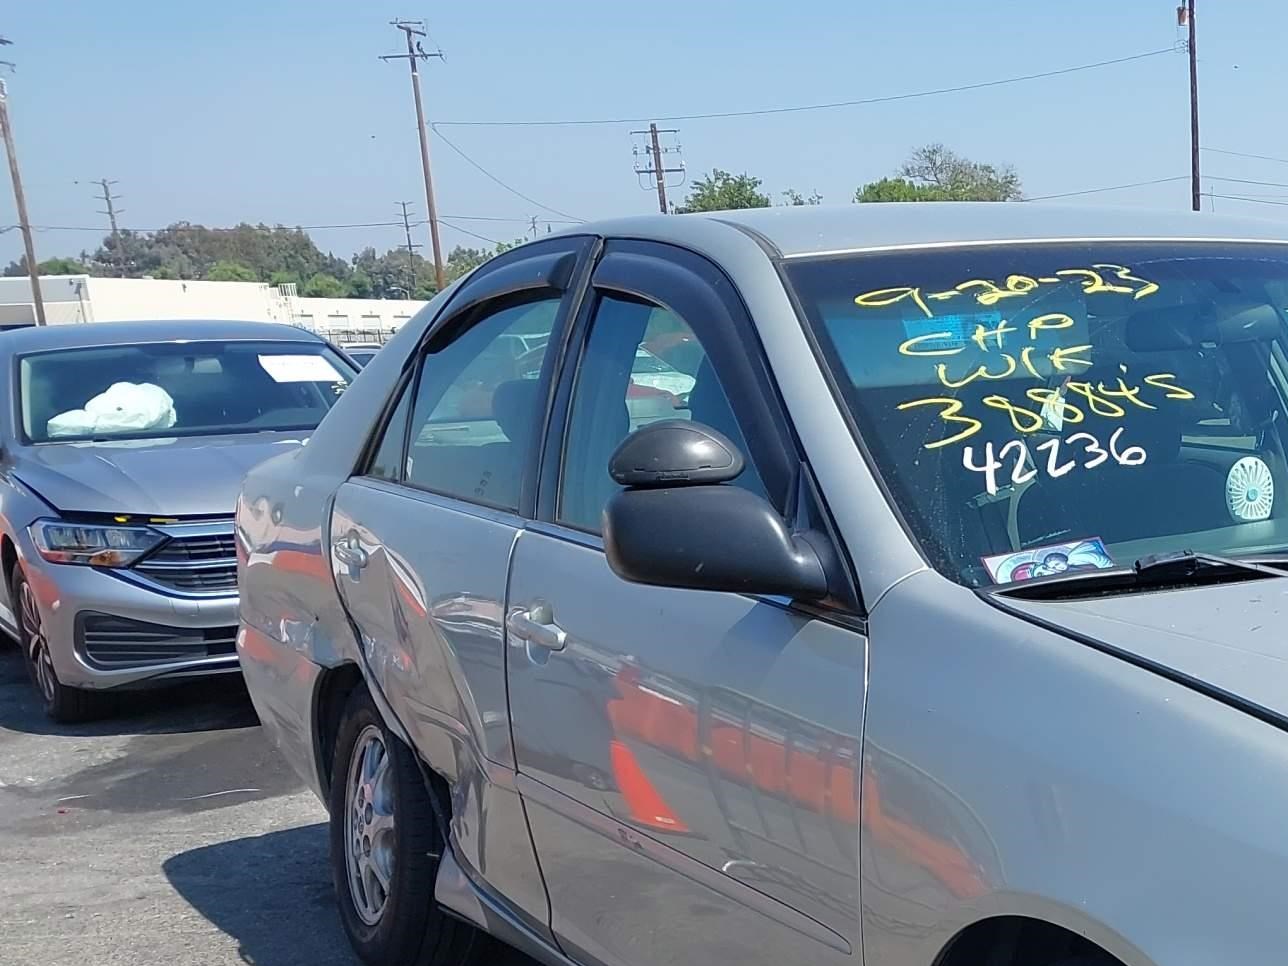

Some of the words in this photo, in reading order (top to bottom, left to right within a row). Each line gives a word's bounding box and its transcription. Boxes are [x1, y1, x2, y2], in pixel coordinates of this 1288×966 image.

[854, 264, 1160, 318] 9-20-23
[898, 313, 1075, 356] CHP
[962, 426, 1147, 496] 42236
